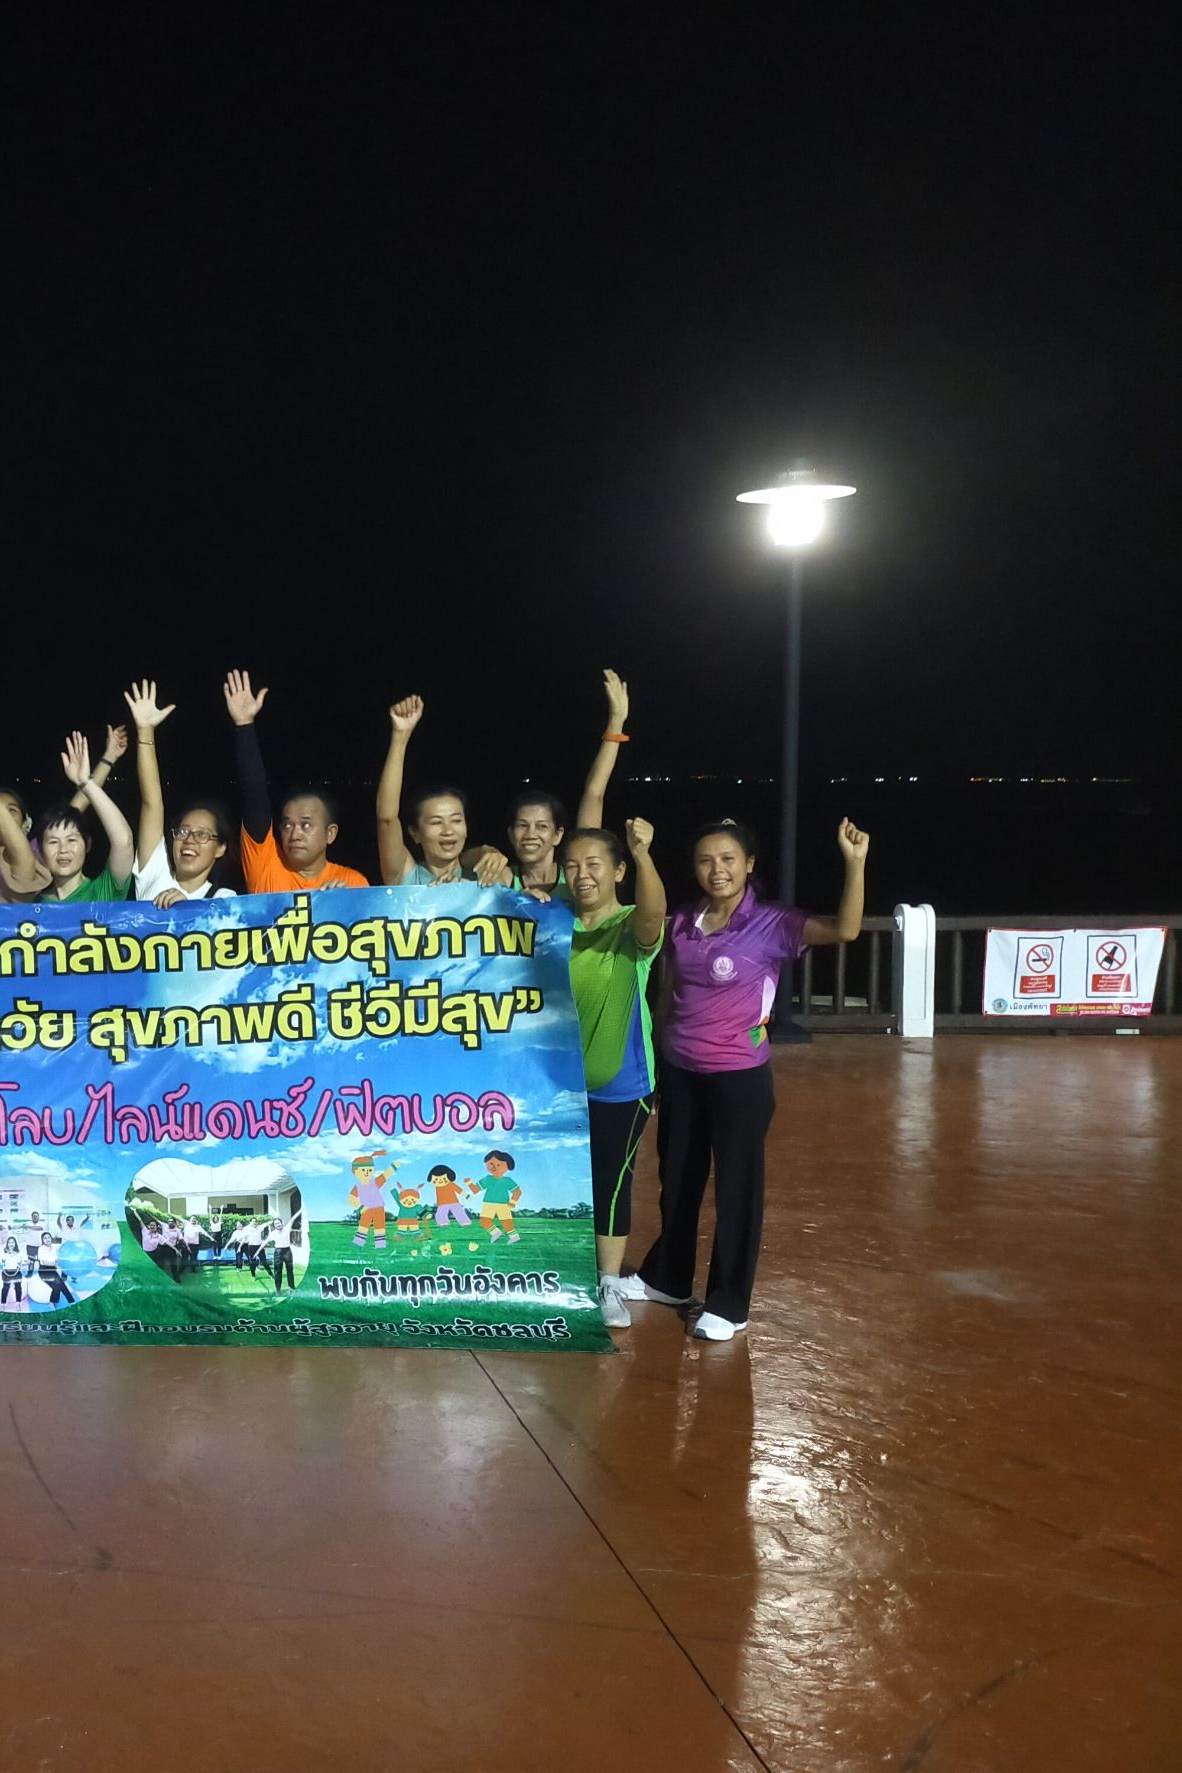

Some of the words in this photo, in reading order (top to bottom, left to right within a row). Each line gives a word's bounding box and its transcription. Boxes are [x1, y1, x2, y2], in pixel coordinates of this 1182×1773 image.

[89, 983, 314, 1063] สุขภาพดี
[319, 1265, 560, 1307] พบกันทุกวันอังคาร
[400, 1317, 572, 1342] จังหวัดชลบุรี
